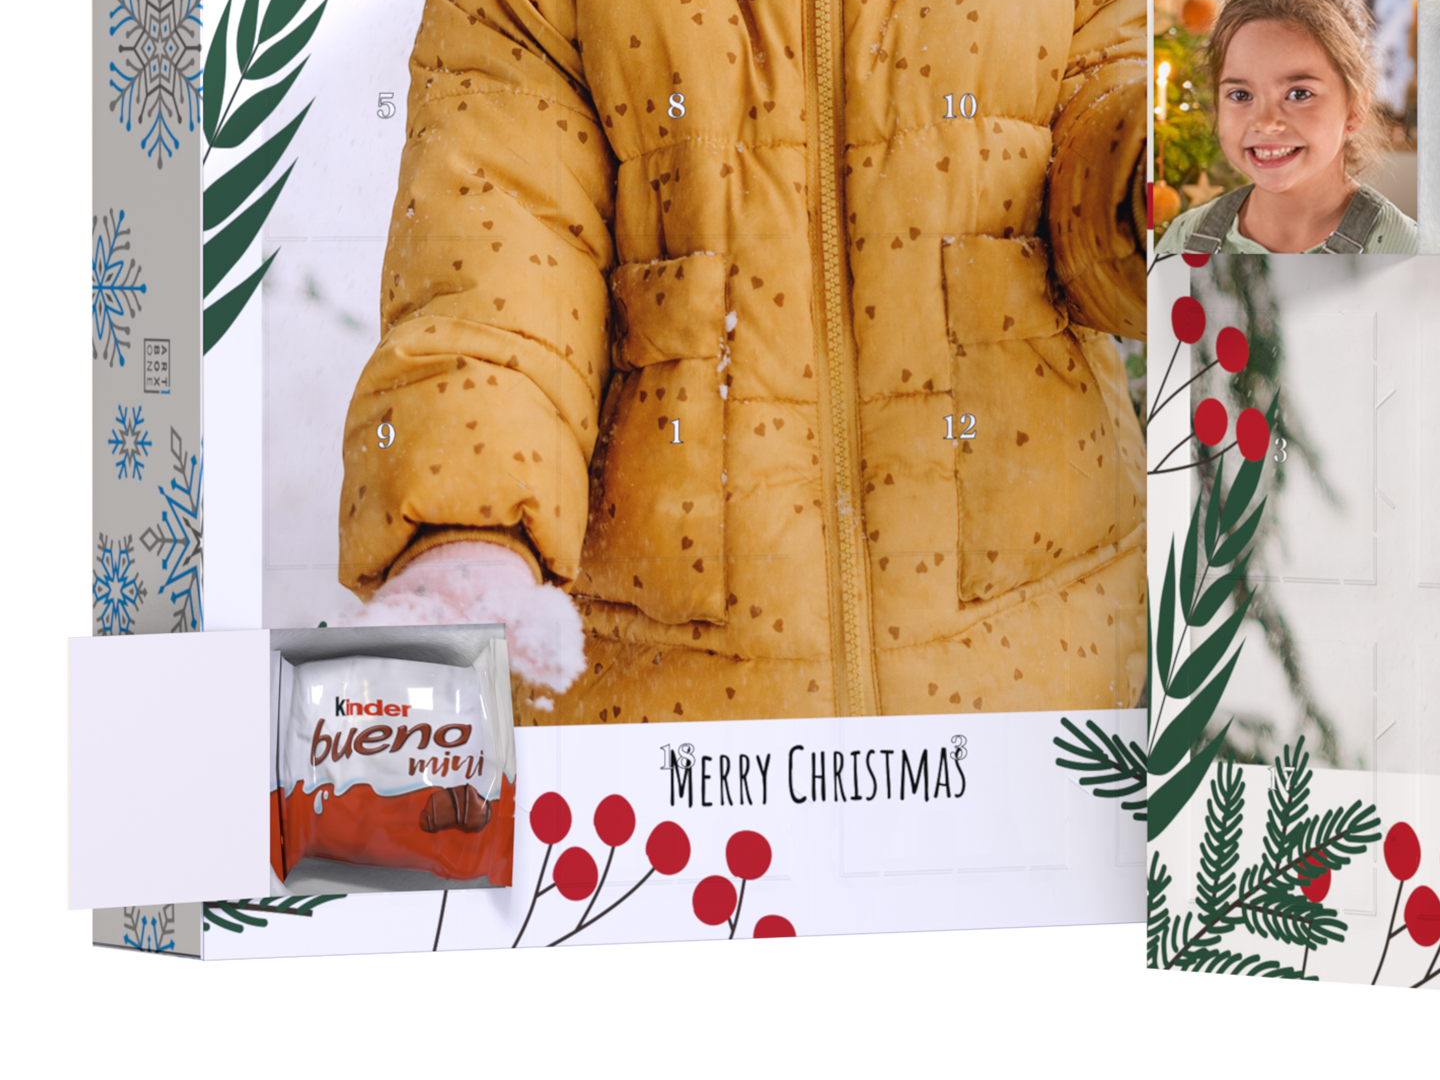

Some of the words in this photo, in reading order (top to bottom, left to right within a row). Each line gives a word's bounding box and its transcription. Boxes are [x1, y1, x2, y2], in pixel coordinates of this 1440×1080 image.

[376, 92, 396, 119] 5
[667, 92, 687, 119] 8
[942, 92, 978, 119] 10
[376, 422, 396, 449] 9
[669, 418, 684, 444] 1
[942, 413, 977, 440] 12
[1273, 437, 1288, 463] 3
[335, 696, 413, 717] kinder
[310, 718, 473, 767] bueno
[949, 734, 968, 761] 3
[408, 750, 484, 780] mini
[660, 743, 696, 770] 18
